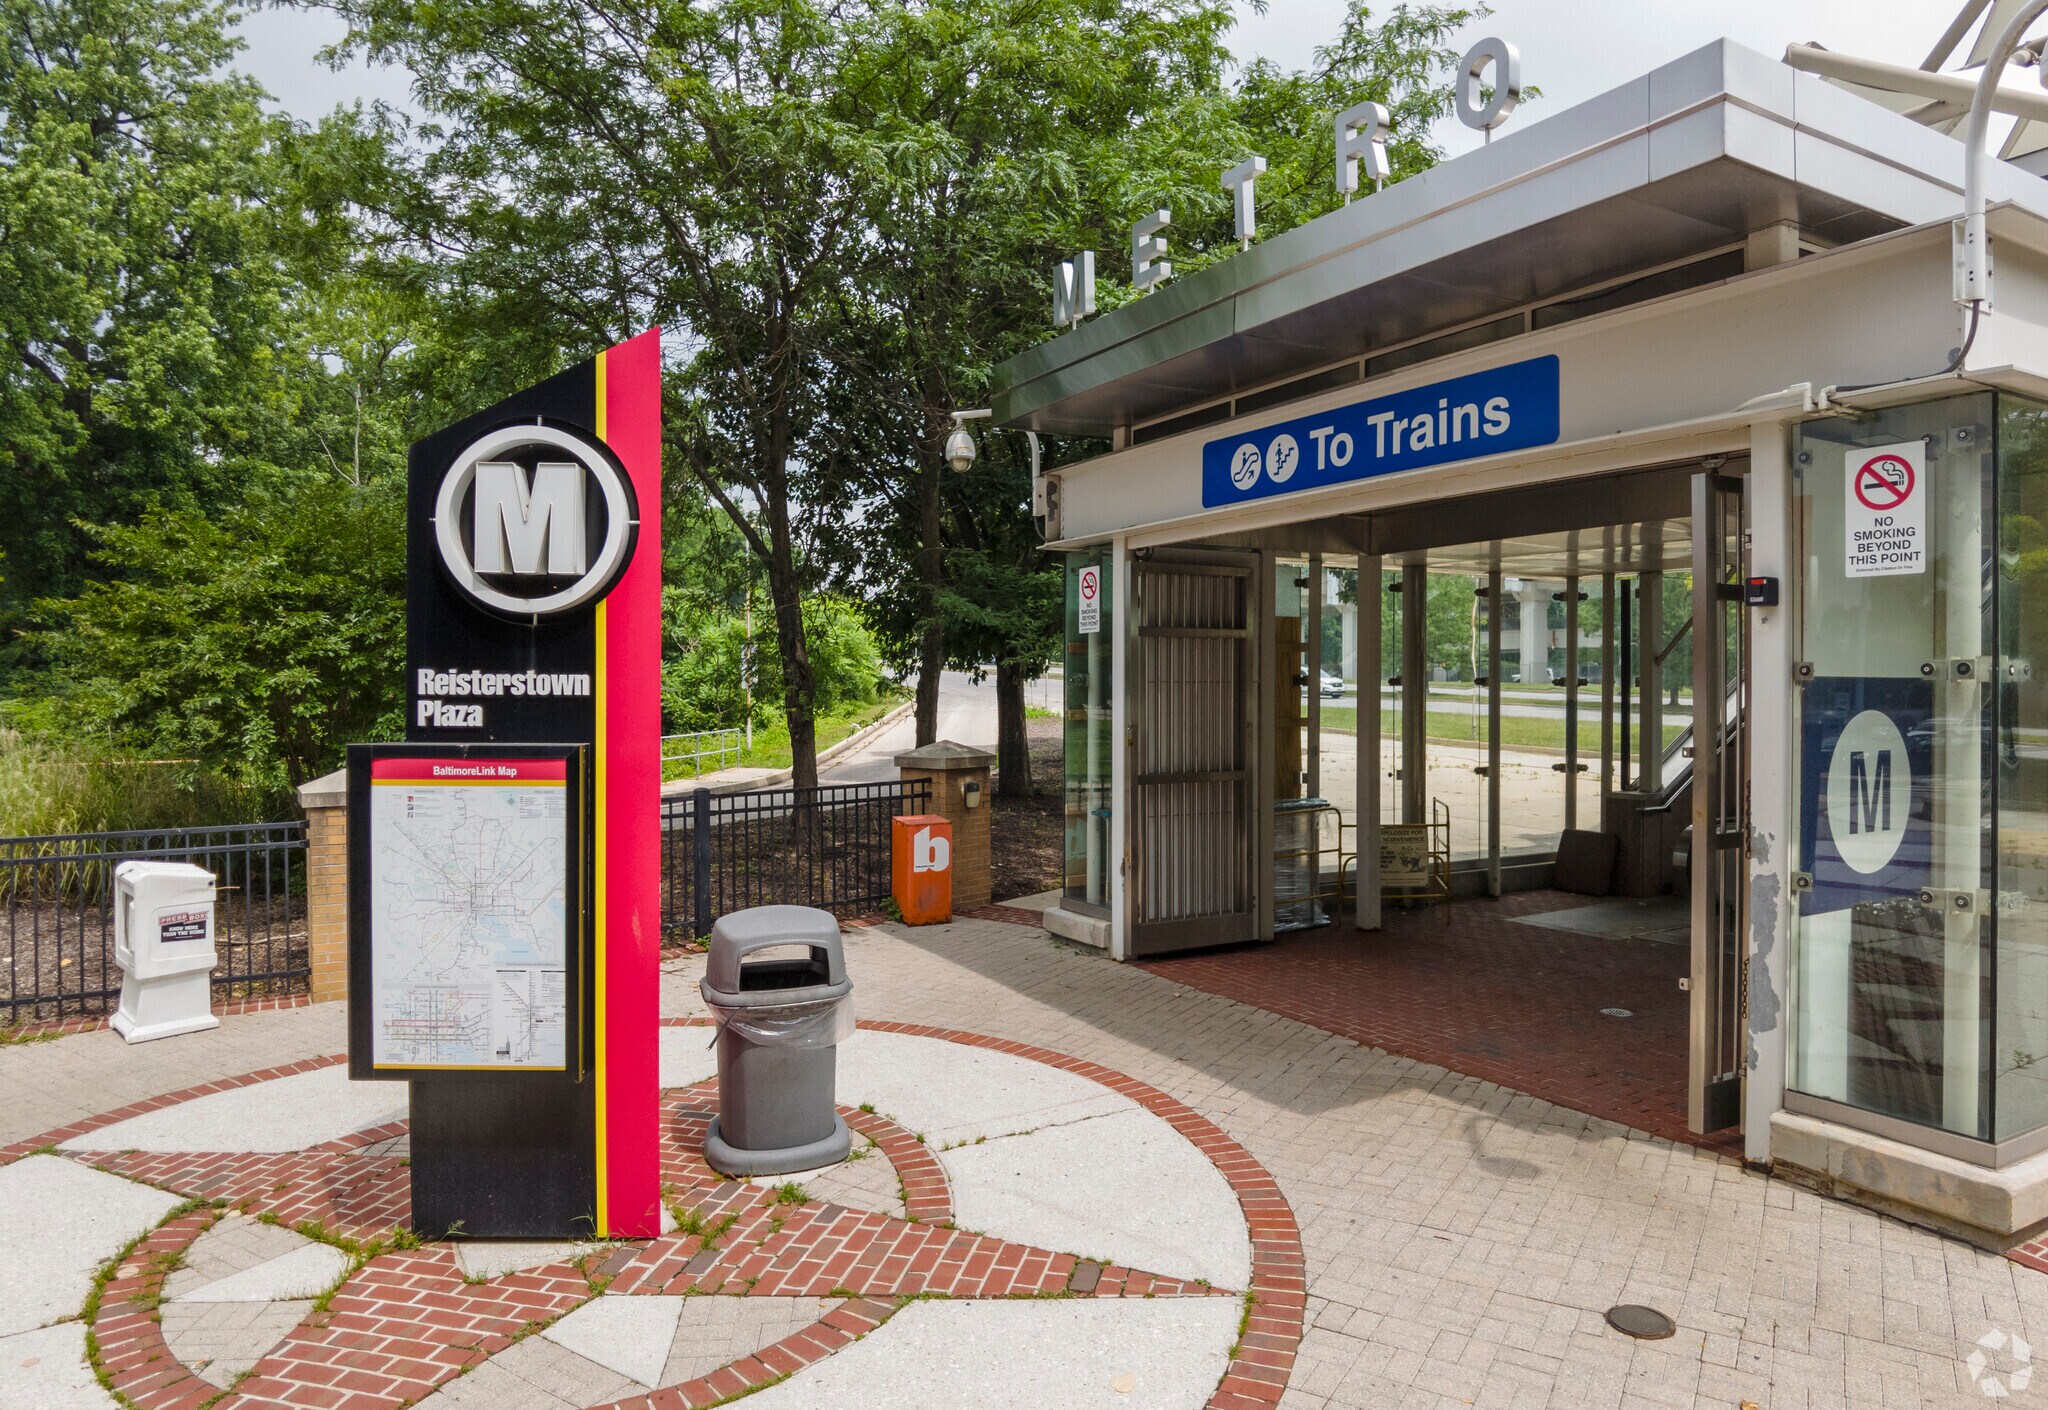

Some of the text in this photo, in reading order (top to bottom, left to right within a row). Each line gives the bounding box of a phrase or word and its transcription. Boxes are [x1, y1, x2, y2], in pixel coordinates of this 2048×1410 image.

[1053, 37, 1520, 327] METRO
[1310, 396, 1511, 471] To Trains
[474, 461, 587, 576] M
[1874, 516, 1894, 527] NO
[1853, 526, 1916, 541] SMOKING
[1857, 539, 1911, 553] BEYOND
[1848, 551, 1922, 566] THIS POINT
[416, 668, 591, 696] Reisterstown
[416, 700, 484, 728] Plaza
[433, 765, 517, 779] BaltimoreLink Map
[1848, 750, 1892, 835] M
